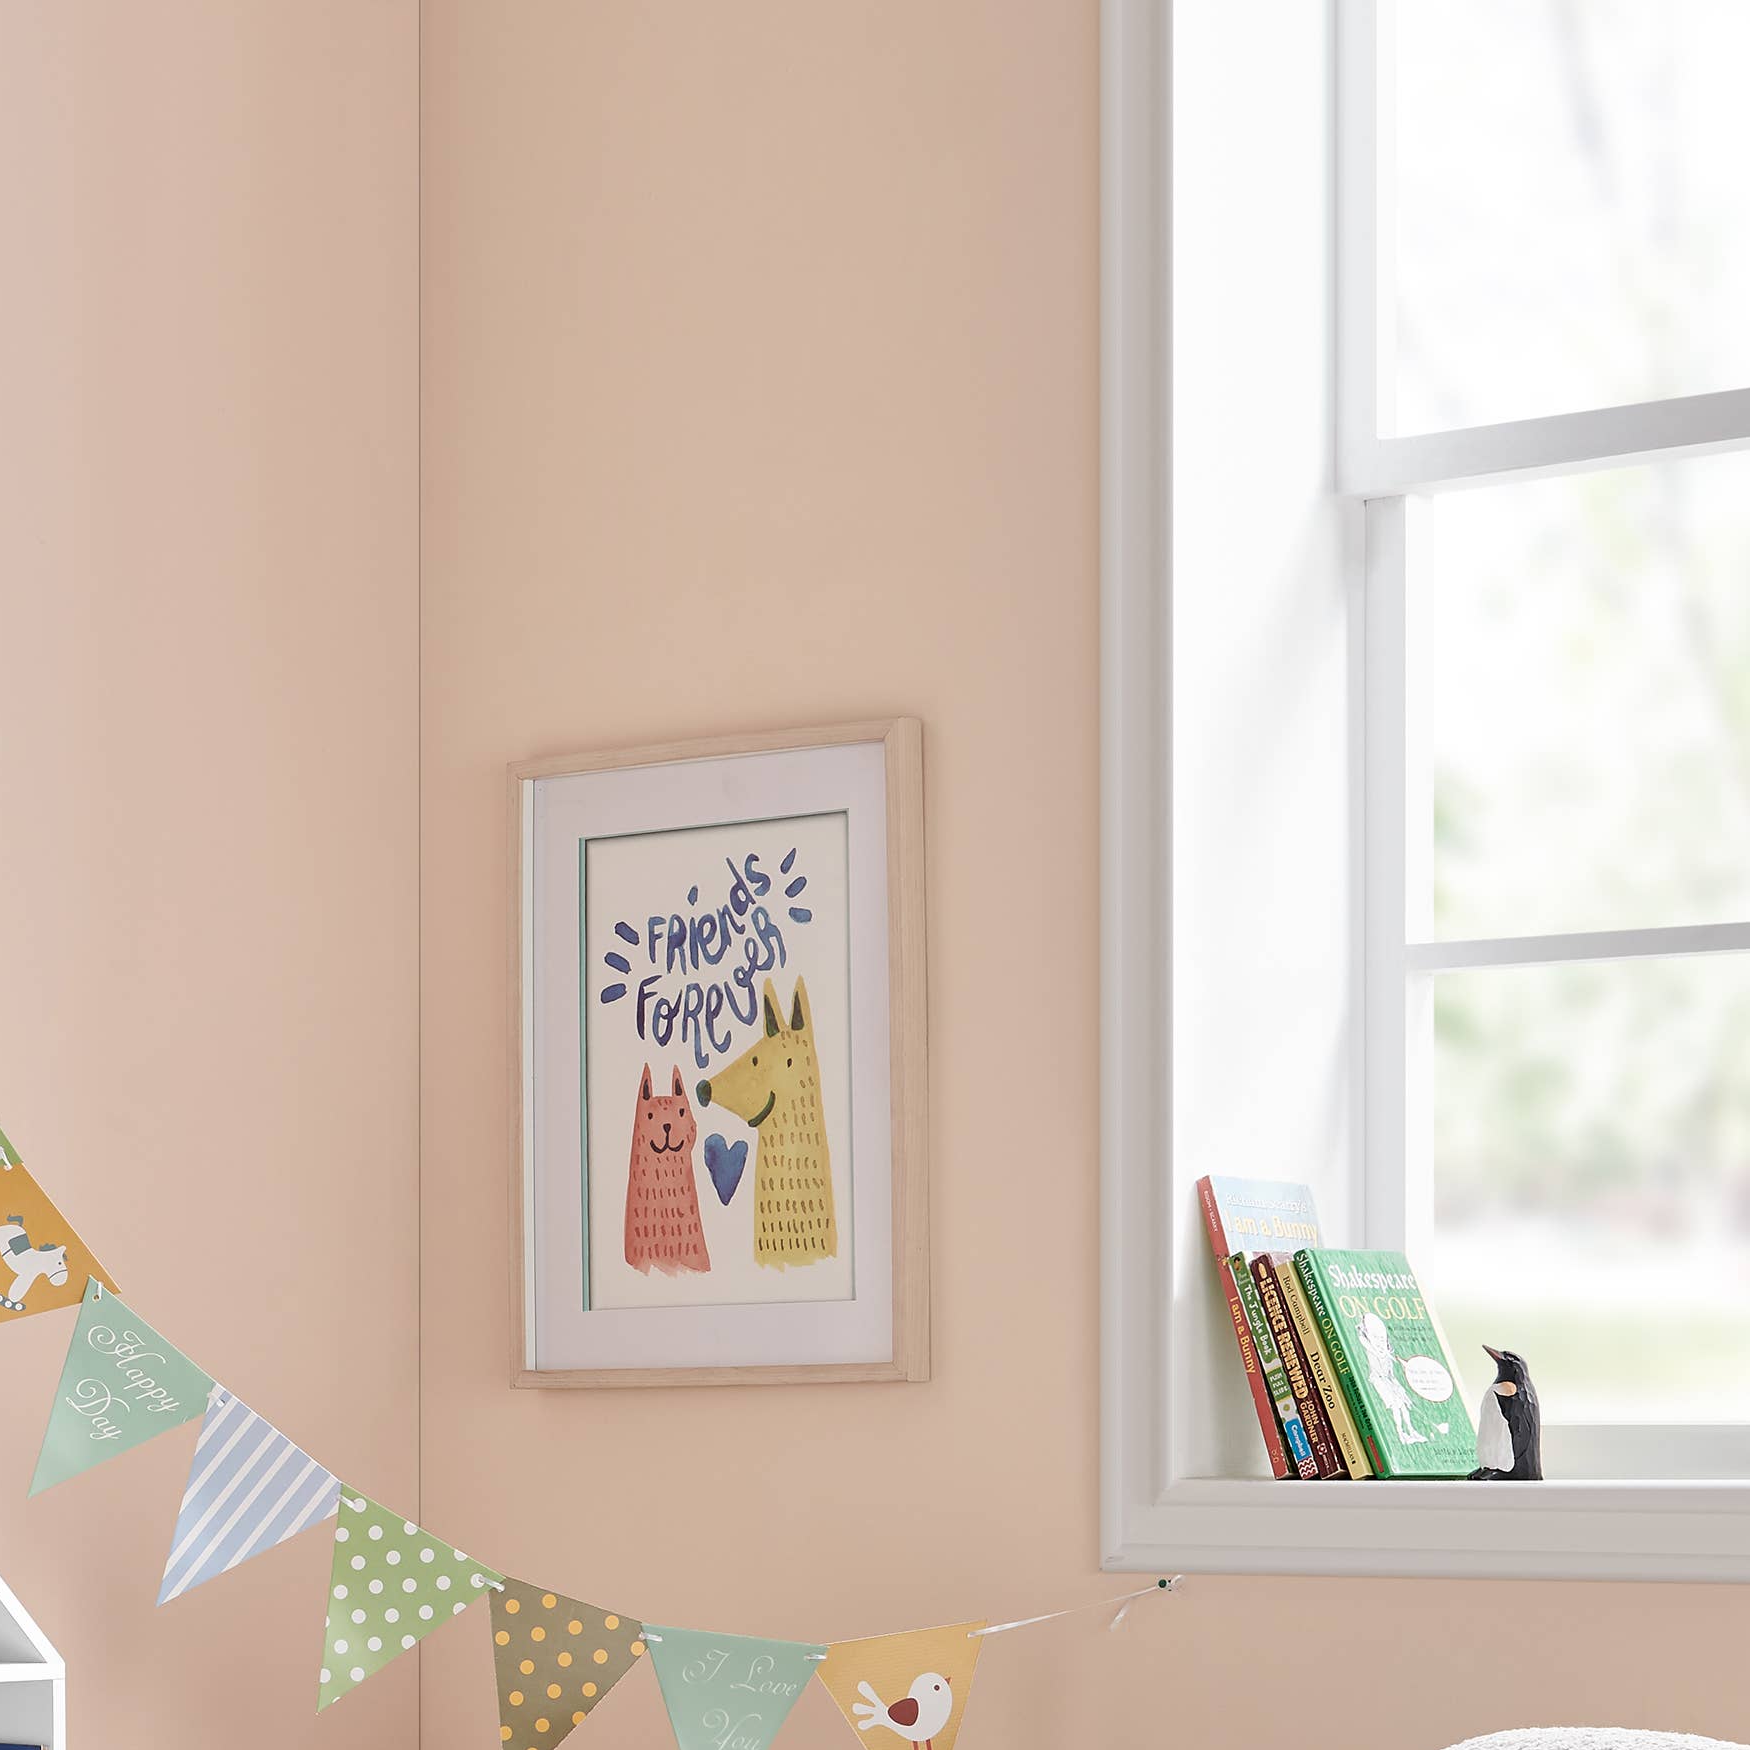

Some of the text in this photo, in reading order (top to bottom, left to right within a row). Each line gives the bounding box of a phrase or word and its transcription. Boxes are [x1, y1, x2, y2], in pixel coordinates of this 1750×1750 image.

[1328, 1264, 1418, 1294] Shakespeare
[1243, 1285, 1253, 1300] The
[1249, 1302, 1263, 1334] Jungle
[1259, 1334, 1273, 1356] Book
[1290, 1294, 1311, 1336] Campbell
[1296, 1252, 1351, 1375] Shakespeare ON GOLF
[1339, 1295, 1427, 1320] ON GOLF
[1240, 1335, 1256, 1374] Bunny
[1260, 1277, 1309, 1399] LICENCE RENEWED
[87, 1324, 181, 1413] Happy
[1310, 1352, 1336, 1410] Dear Zoo
[65, 1378, 131, 1441] Day
[1300, 1402, 1319, 1444] GARDNER
[1306, 1399, 1320, 1425] JOHN
[730, 1655, 797, 1697] Love
